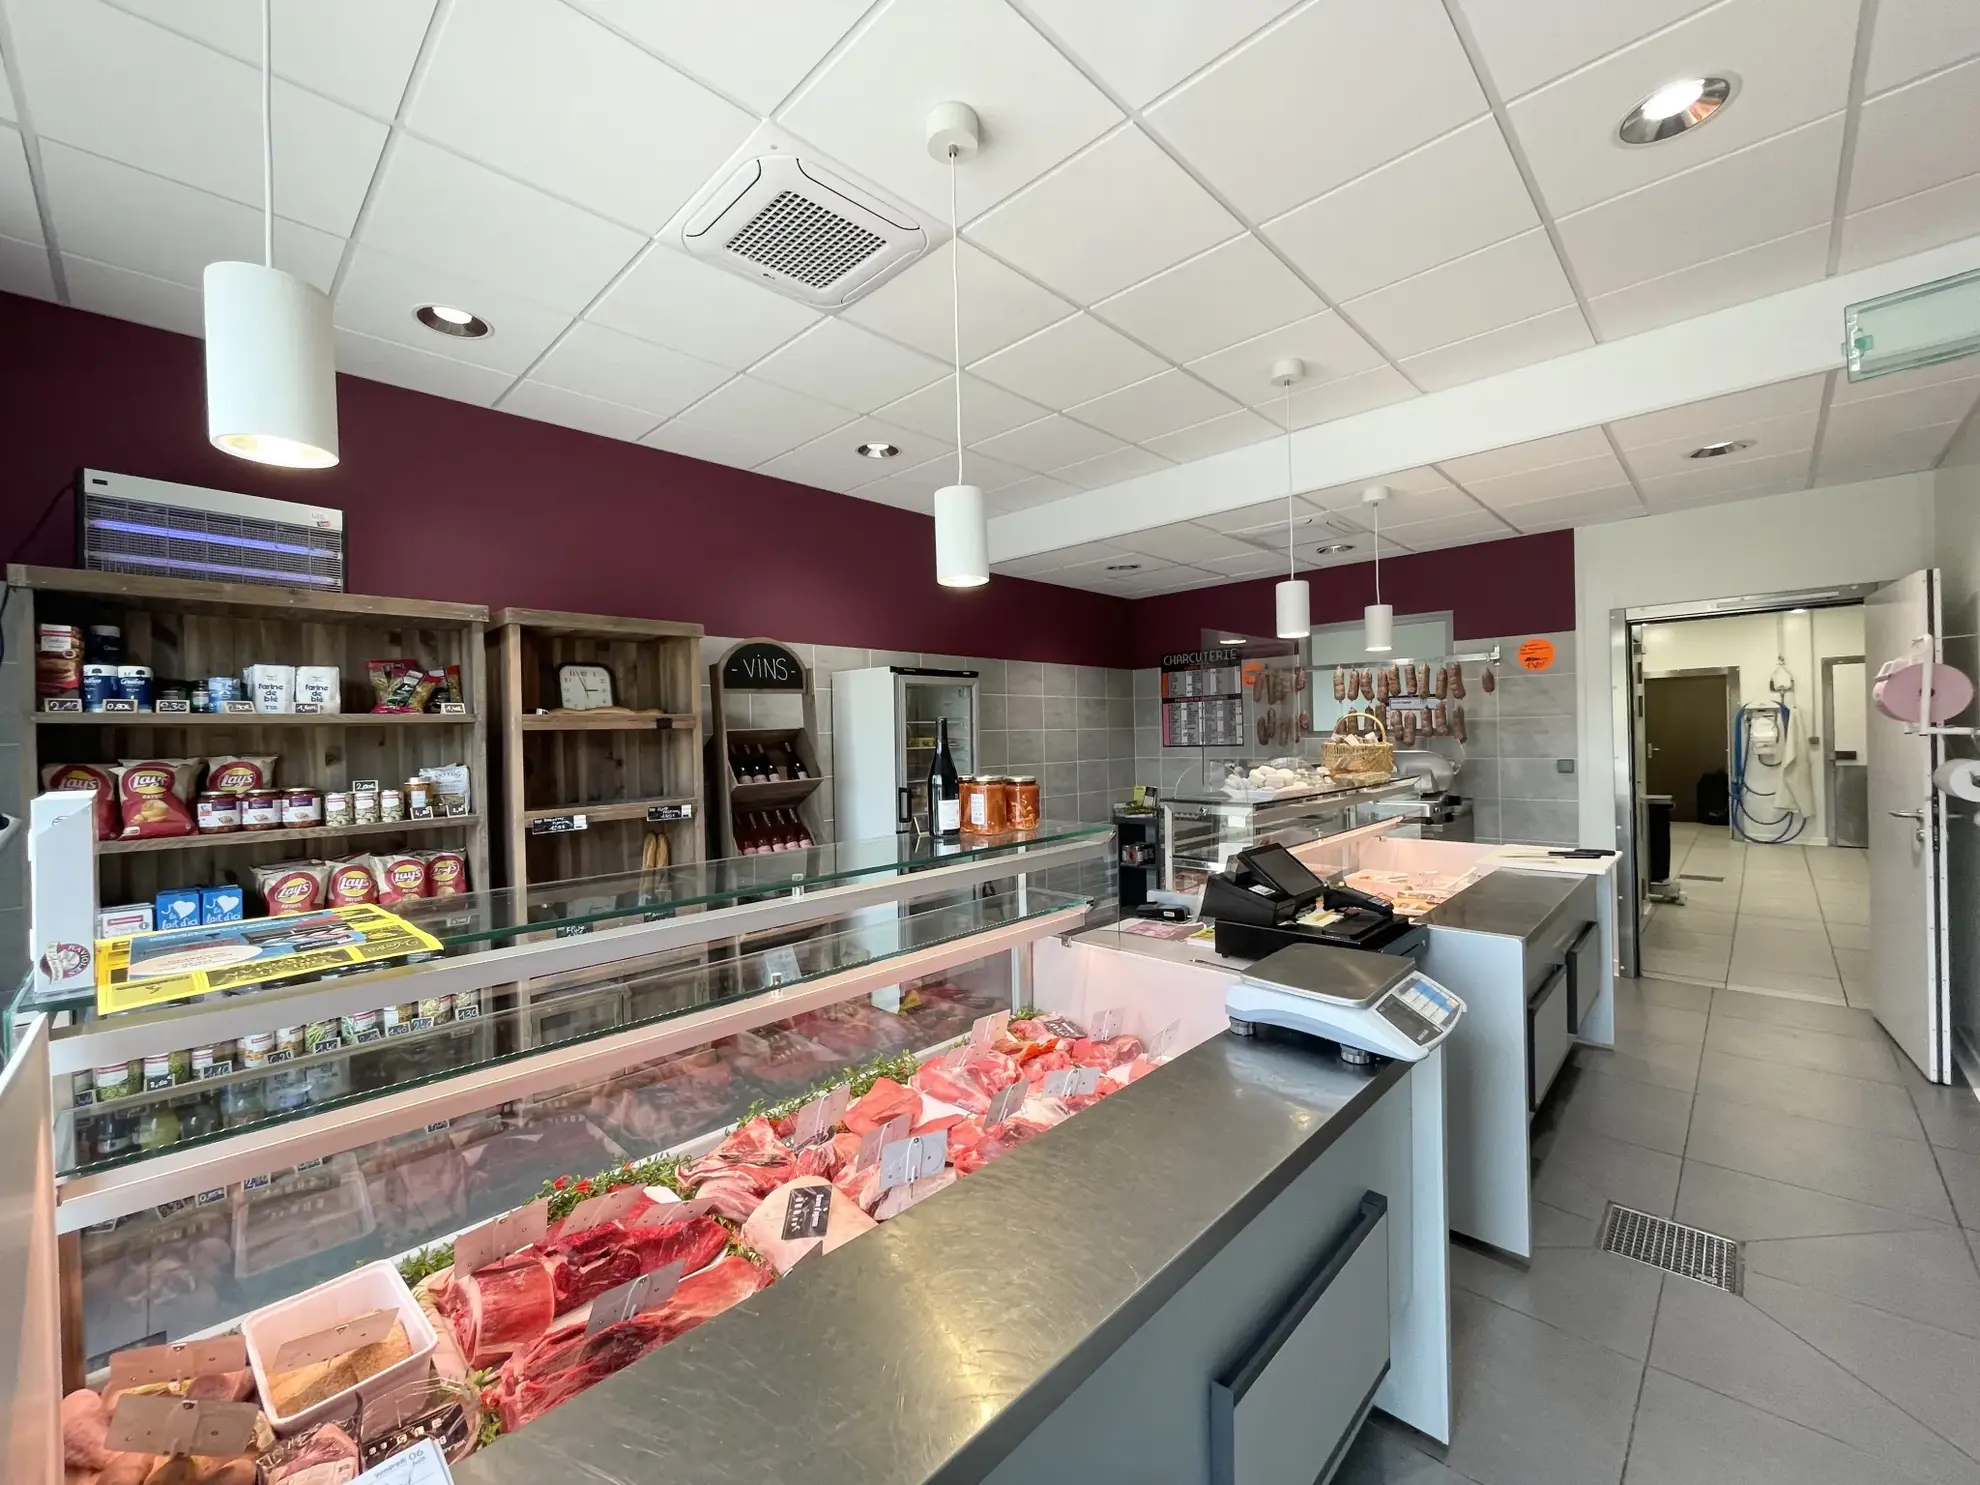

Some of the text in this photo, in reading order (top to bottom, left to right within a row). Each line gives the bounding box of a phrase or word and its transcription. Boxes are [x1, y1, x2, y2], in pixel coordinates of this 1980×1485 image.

[1163, 648, 1237, 666] CHARCUTERIE
[258, 682, 284, 691] farine
[305, 683, 329, 692] farine
[408, 1449, 424, 1461] 06
